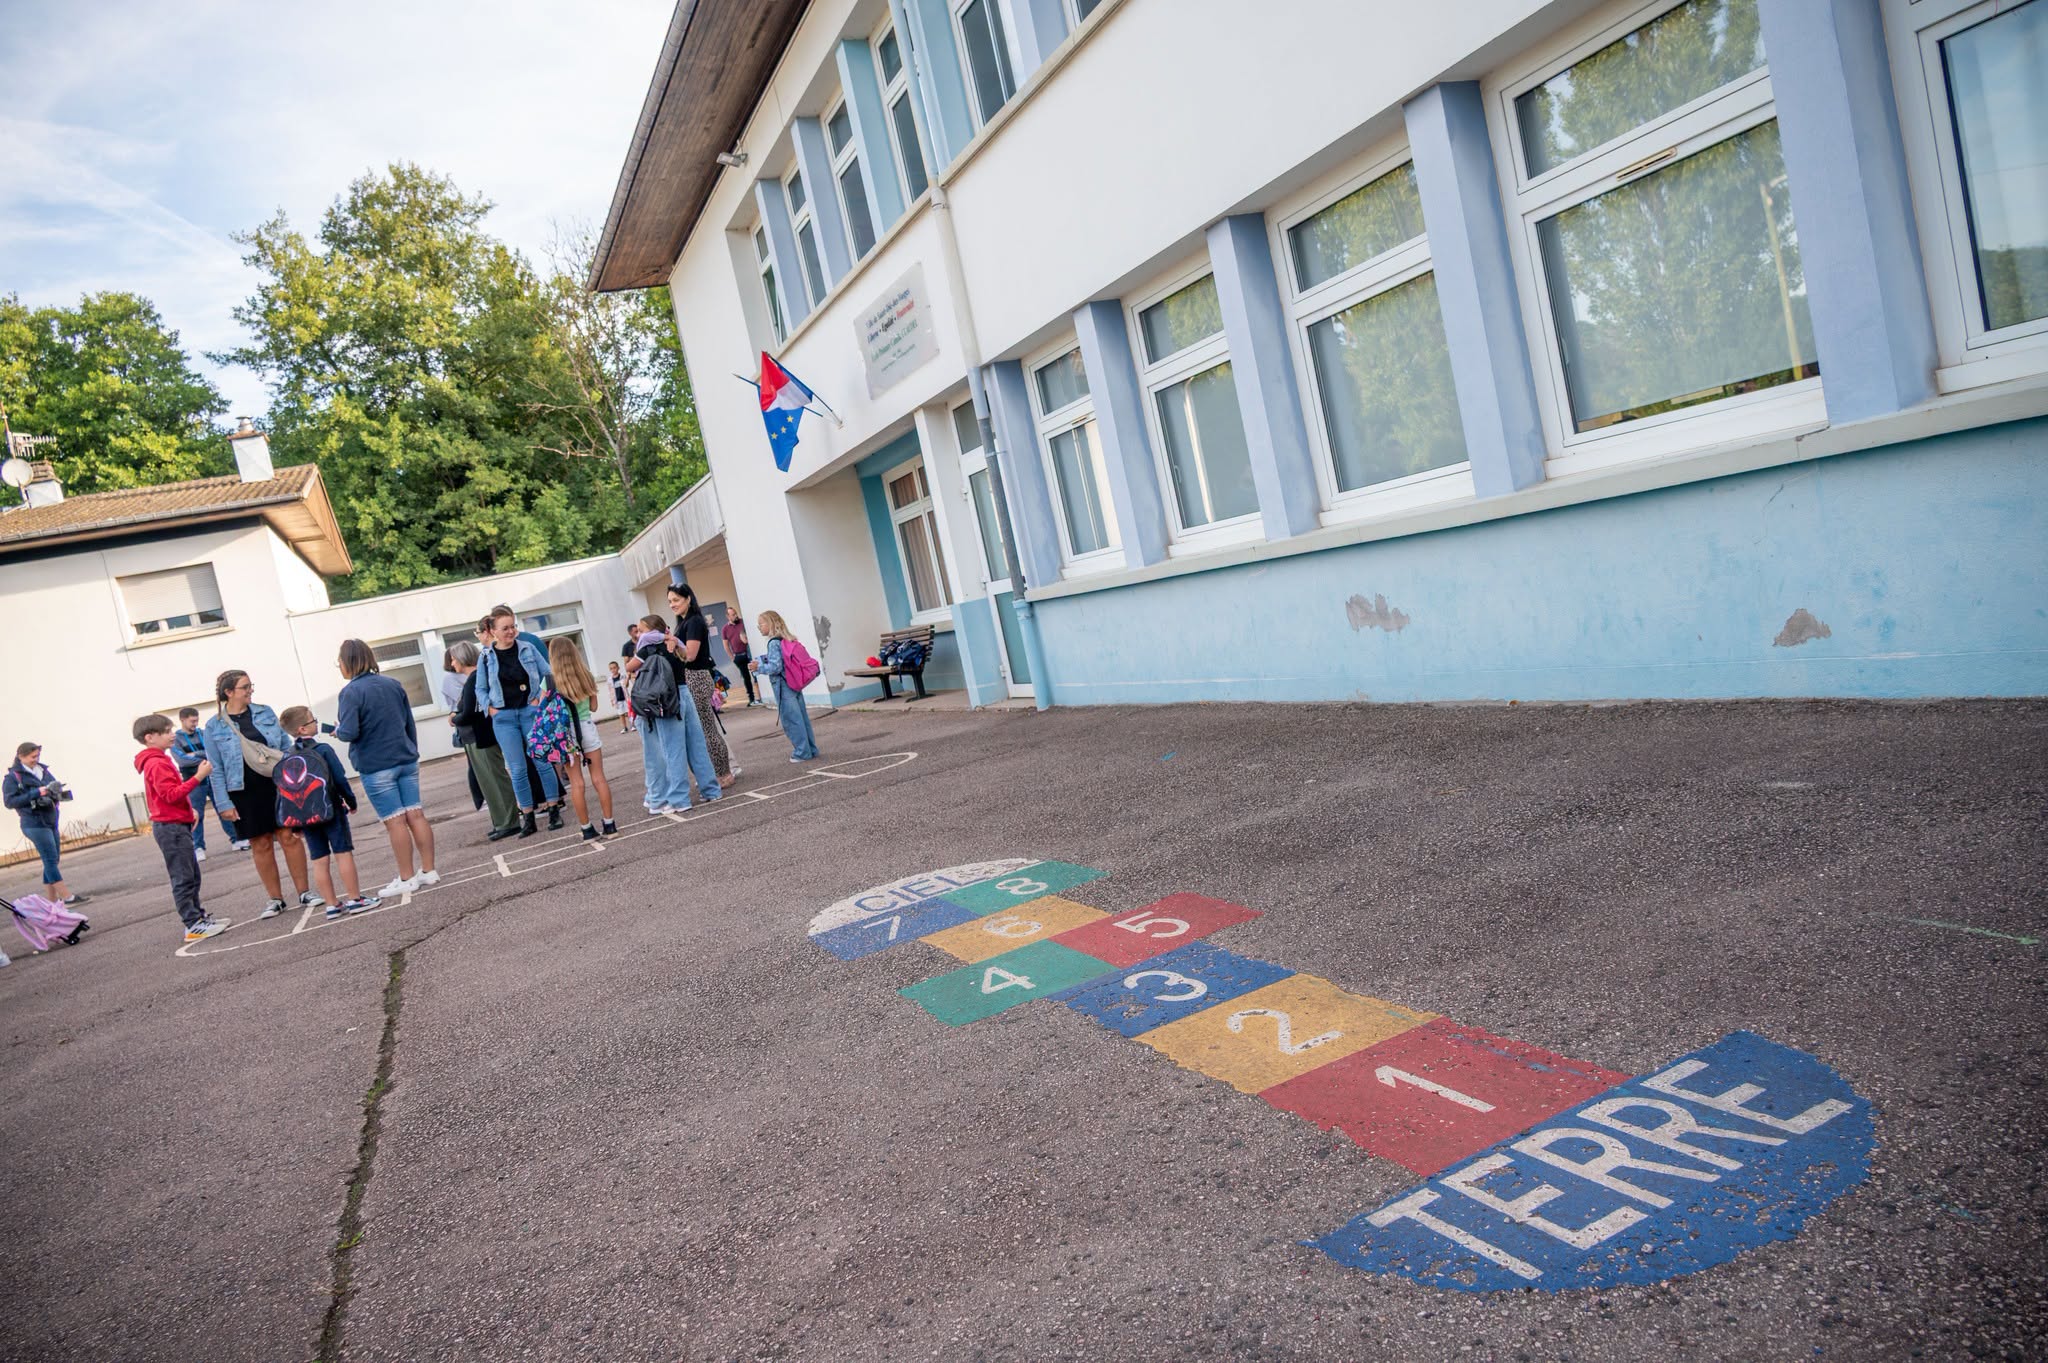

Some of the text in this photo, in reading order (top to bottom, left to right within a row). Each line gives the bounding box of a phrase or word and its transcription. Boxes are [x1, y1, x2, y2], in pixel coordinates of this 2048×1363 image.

[854, 870, 986, 913] CIEL
[863, 876, 1049, 942] 7 8
[982, 914, 1043, 939] 6
[980, 910, 1191, 995] 4 5
[1123, 969, 1208, 1003] 3
[1226, 1008, 1344, 1055] 2
[1374, 1064, 1497, 1114] 1
[1365, 1059, 1853, 1281] TERRE
